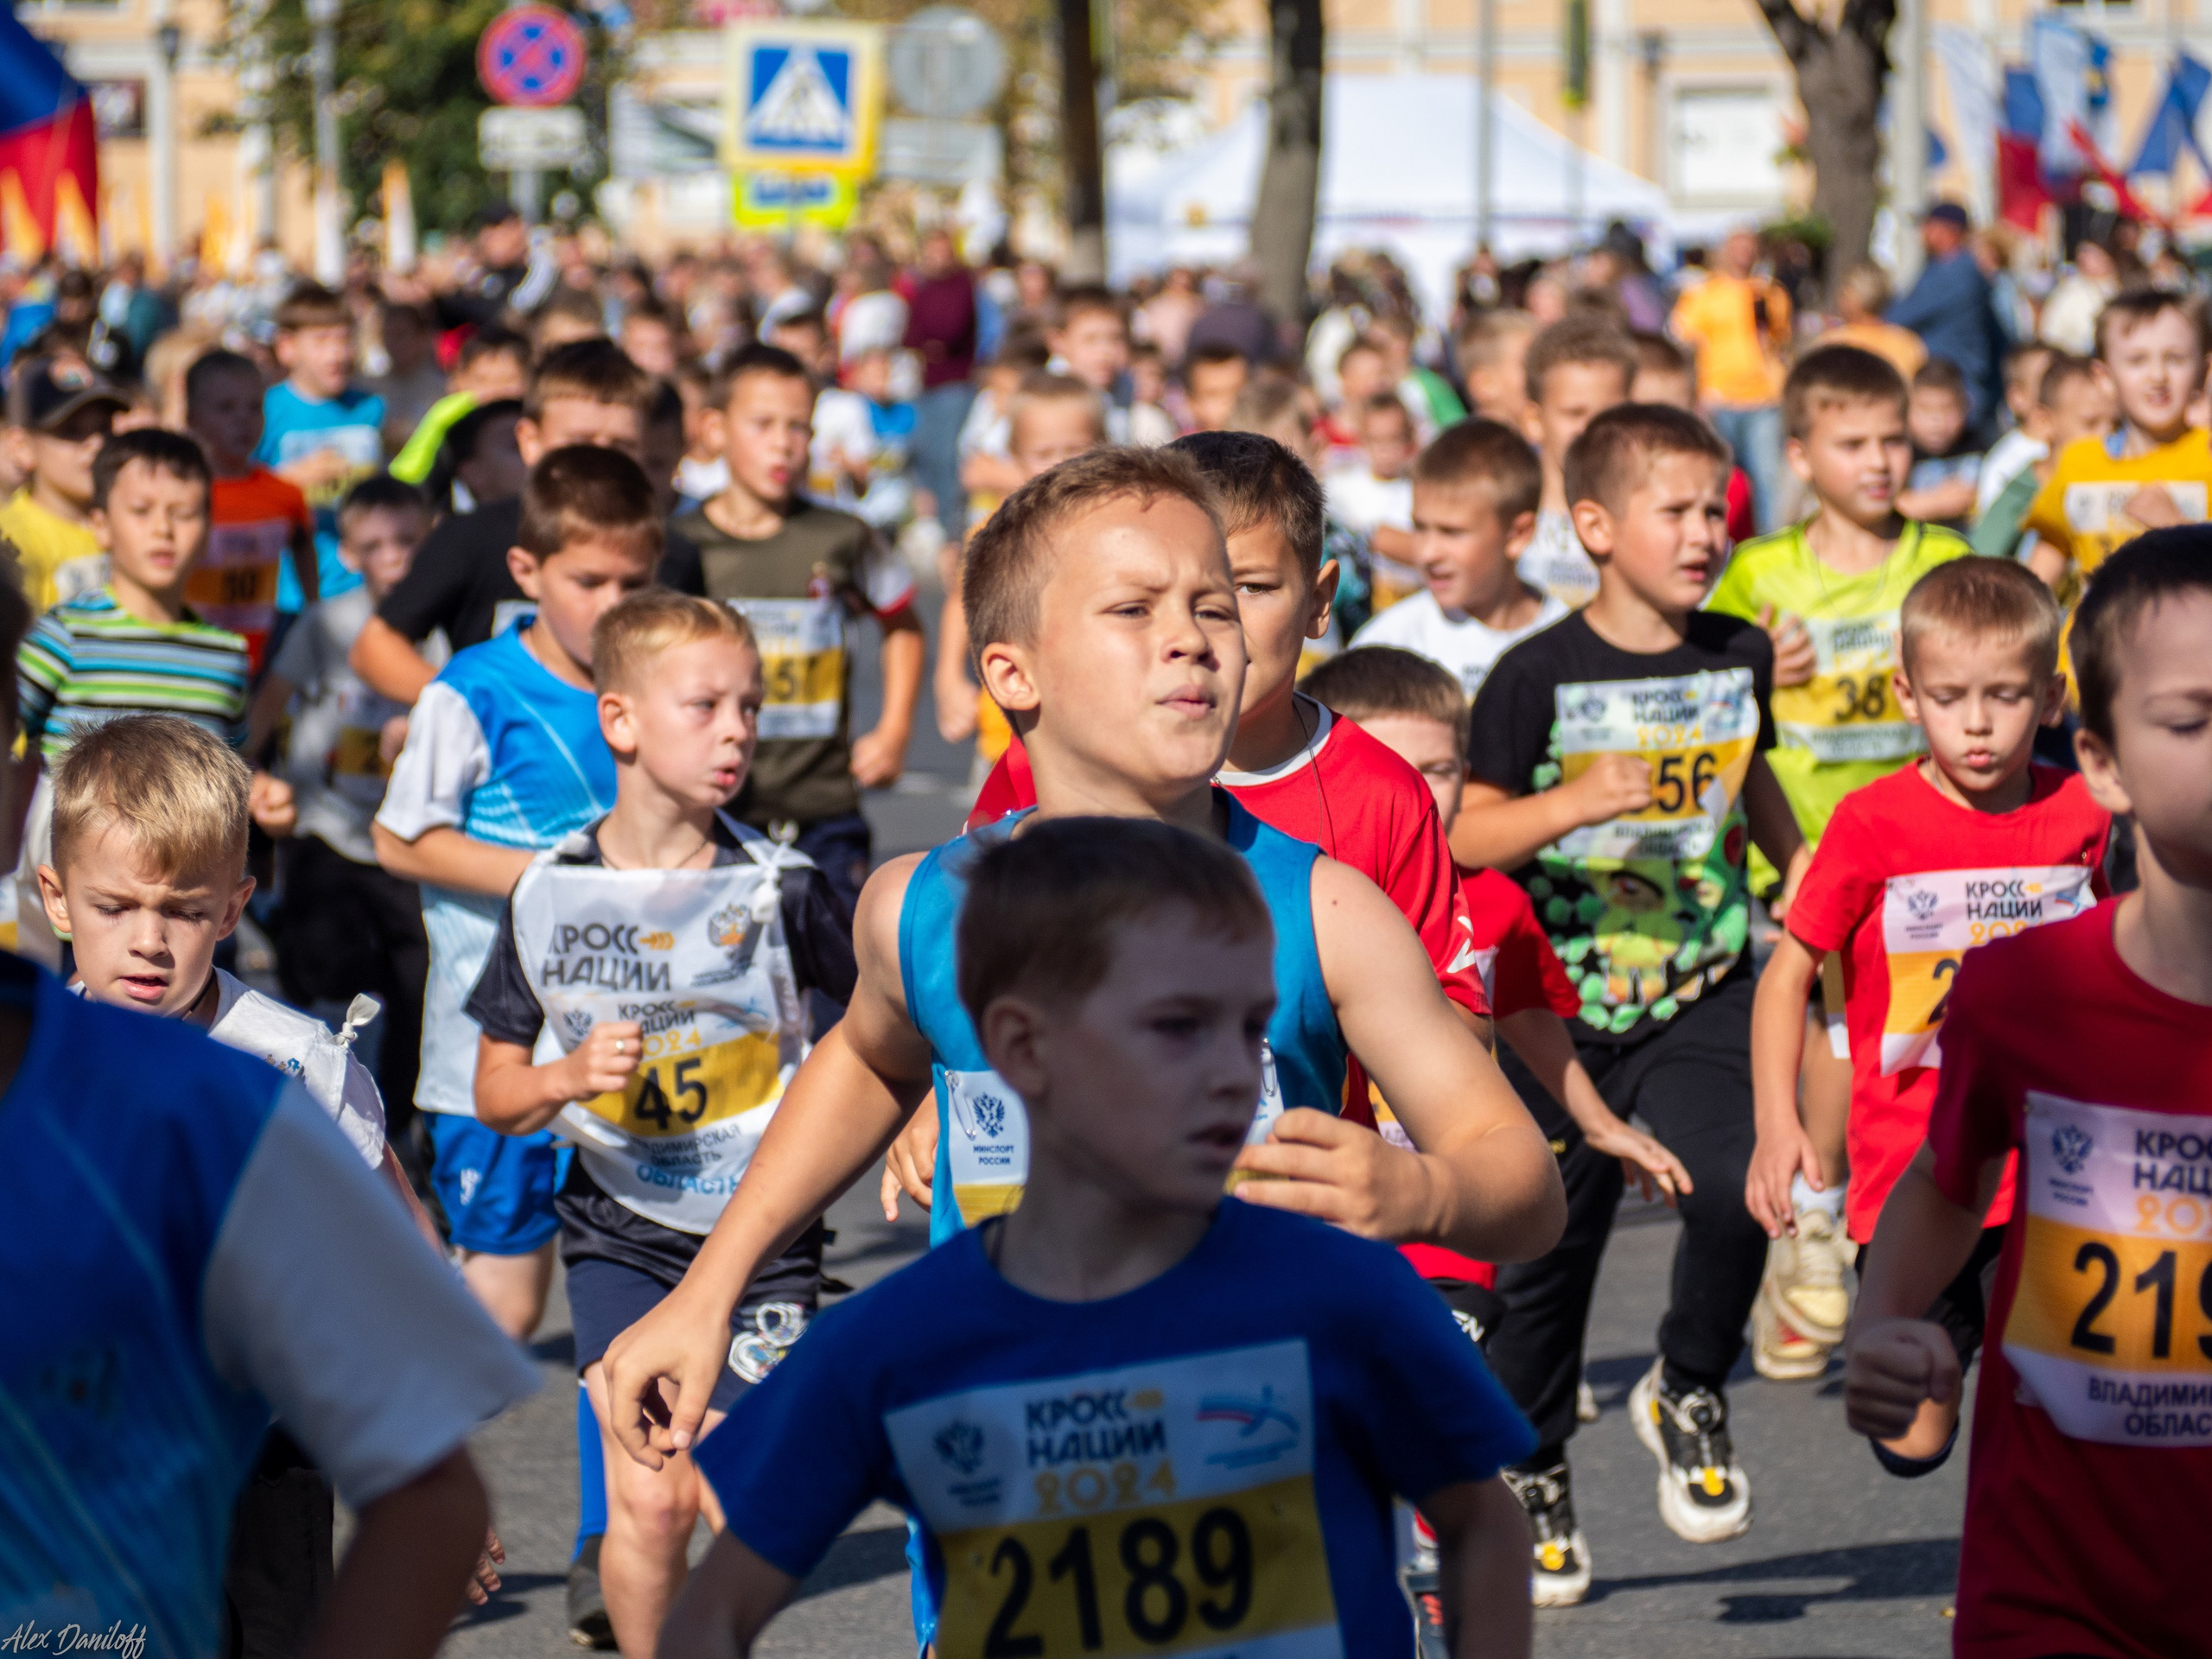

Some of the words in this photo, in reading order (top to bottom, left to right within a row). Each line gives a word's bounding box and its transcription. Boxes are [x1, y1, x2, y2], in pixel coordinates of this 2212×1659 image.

[1633, 705, 1699, 724] НАЦИИ
[1637, 722, 1702, 748] 2024
[1656, 749, 1718, 814] 56
[1966, 880, 2024, 899] КРОСС
[1967, 900, 2043, 921] НАЦИИ
[541, 955, 672, 992] НАЦИИ
[1927, 957, 1960, 1026] 2
[617, 999, 677, 1021] КРОСС
[640, 1008, 696, 1035] АЦИИ
[642, 1027, 703, 1058] 024
[634, 1057, 708, 1130] 45
[973, 1145, 1014, 1154] МИНСПОРТ
[2136, 1194, 2212, 1236] 20
[2088, 1374, 2212, 1408] ВЛАДИМИ
[1026, 1389, 1128, 1431] КРОСС
[1027, 1419, 1167, 1467] НАЦИИ
[1033, 1458, 1178, 1513] 2024
[983, 1506, 1254, 1659] 2189
